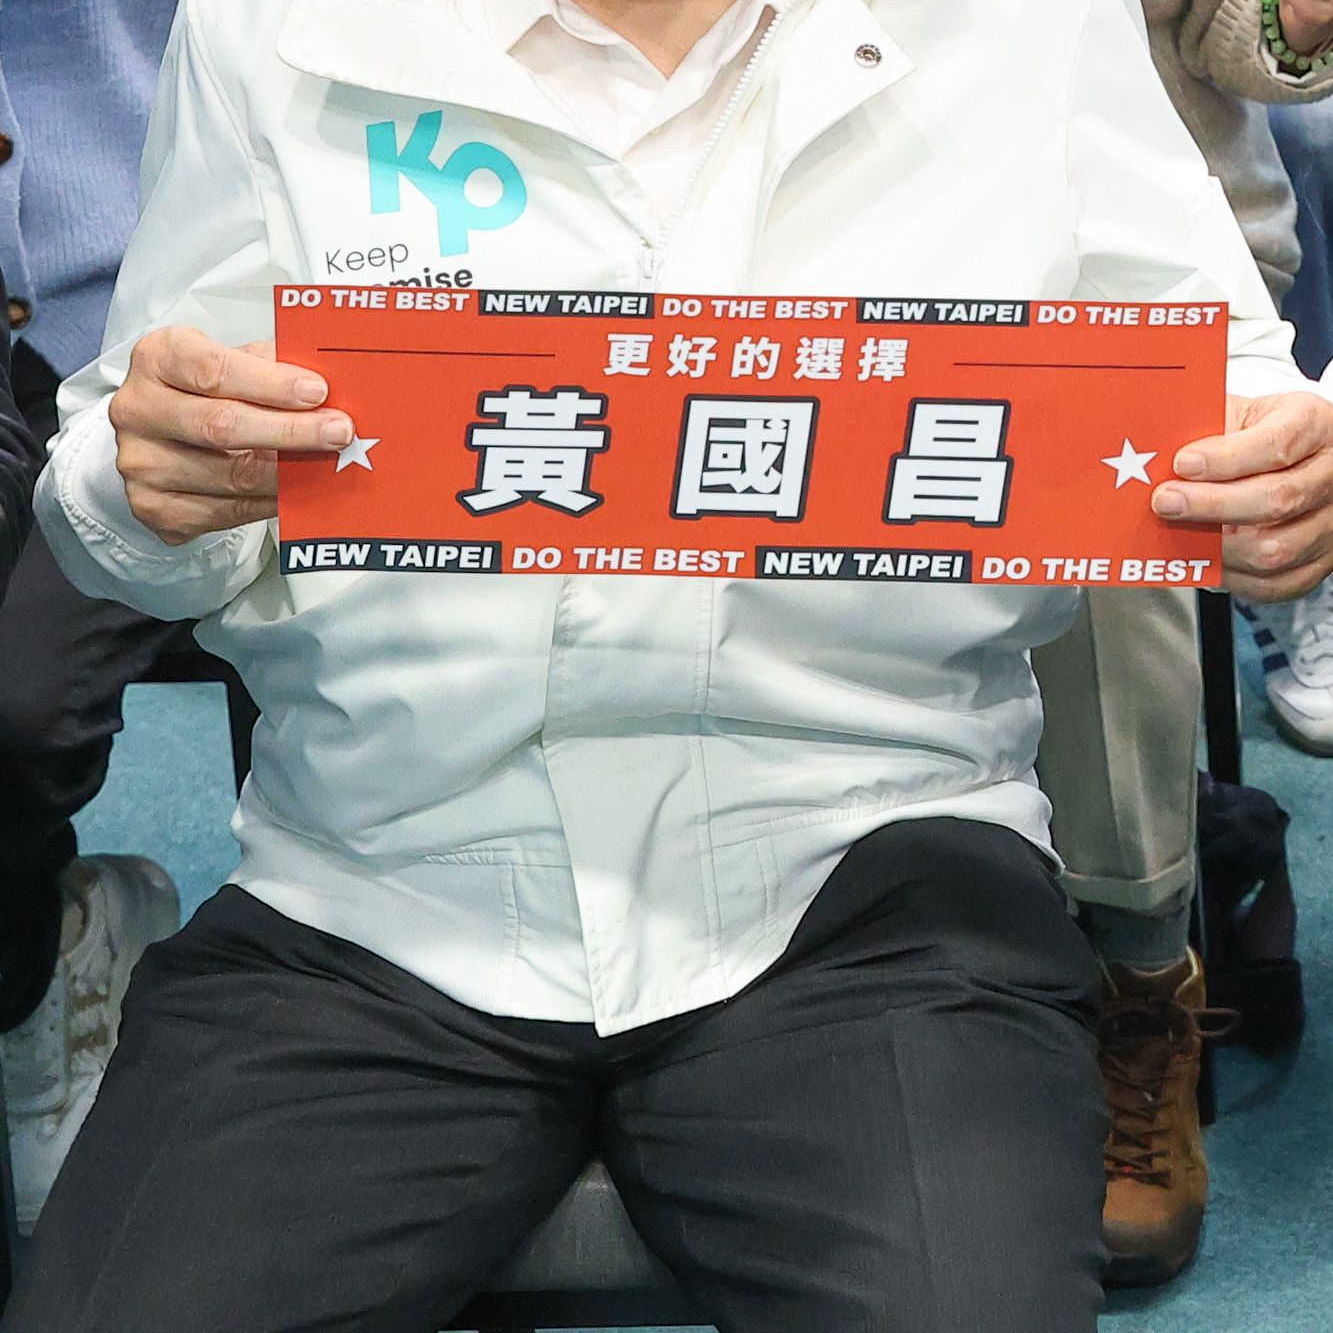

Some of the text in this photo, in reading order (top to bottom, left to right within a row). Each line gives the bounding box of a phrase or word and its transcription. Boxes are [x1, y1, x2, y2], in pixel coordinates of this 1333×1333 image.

[326, 243, 409, 275] Keep
[372, 267, 473, 289] mise
[281, 289, 1221, 326] DO THE BEST NEW TAIPEI DO THE BEST NEW TAIPEI DO THE BEST
[602, 332, 909, 383] 更好的選擇
[459, 388, 1011, 525] 黃國昌
[288, 543, 1211, 582] NEW TAIPEI DO THE BEST NEW TAIPEI DO THE BEST
